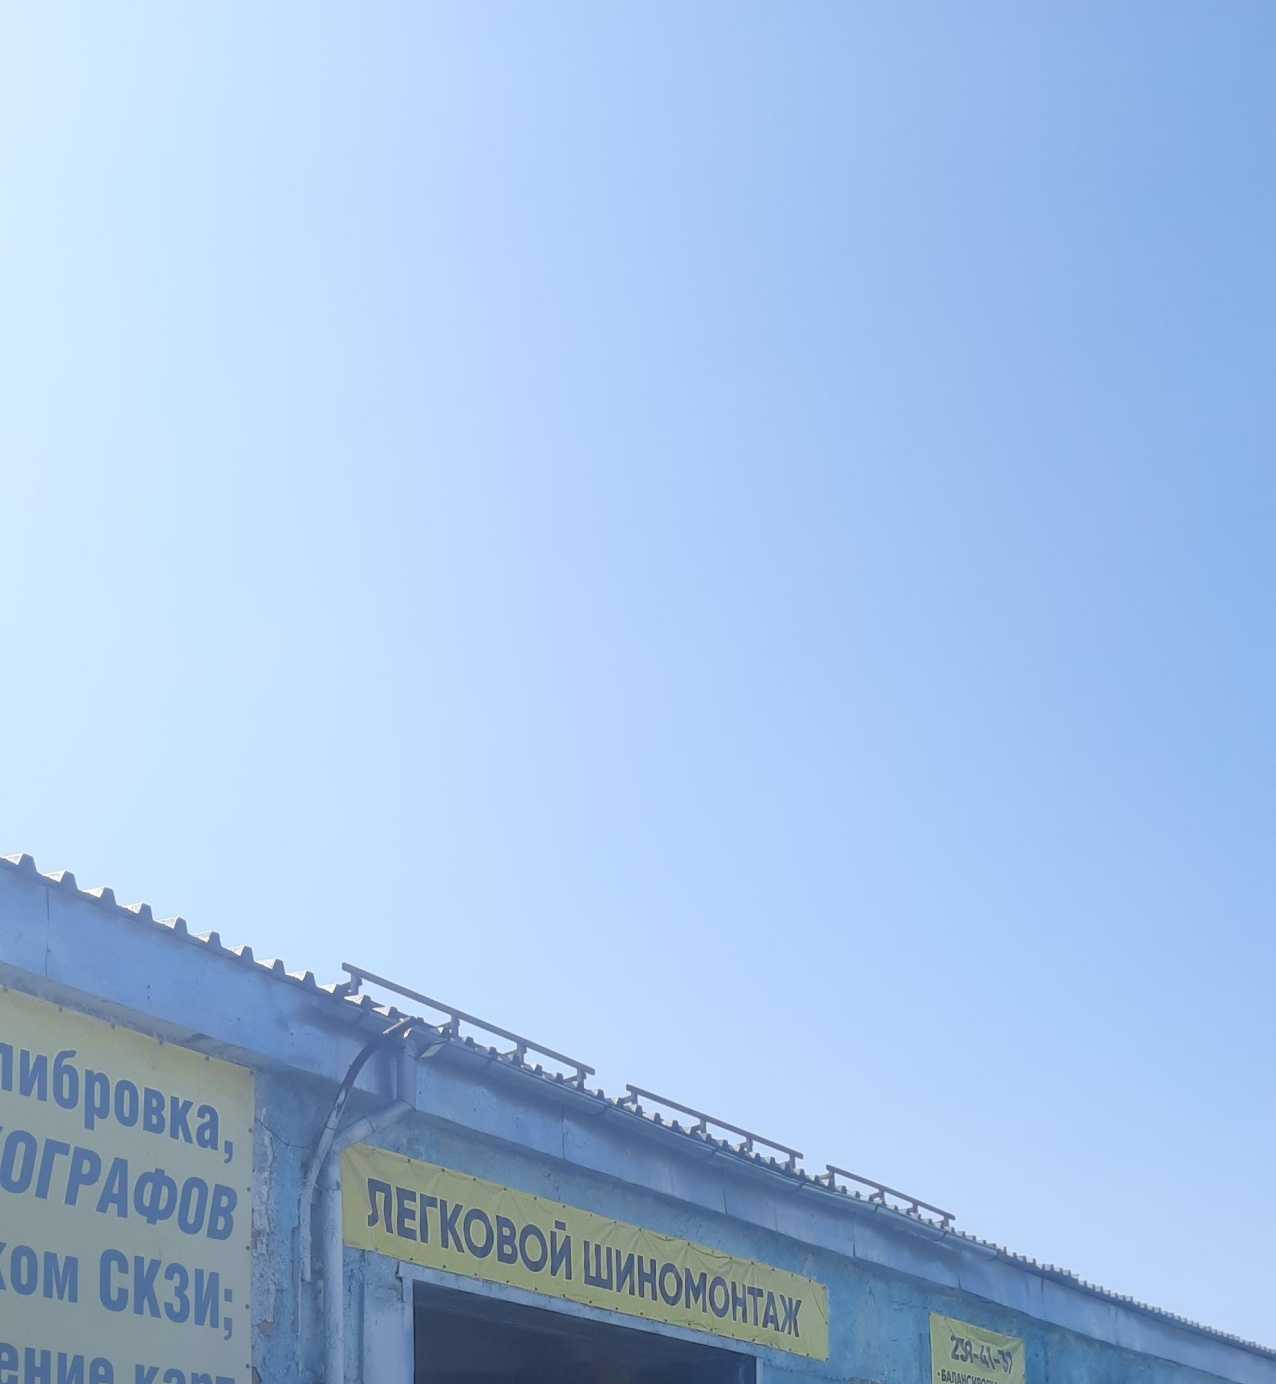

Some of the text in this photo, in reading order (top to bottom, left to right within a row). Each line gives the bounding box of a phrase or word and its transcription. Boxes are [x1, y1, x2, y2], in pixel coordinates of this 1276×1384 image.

[0, 1127, 237, 1241] ОГРАФОВ
[0, 1242, 233, 1340] ом СКЗИ;
[367, 1177, 802, 1338] ЛЕГКОВОЙ ШИНОМОНТАЖ
